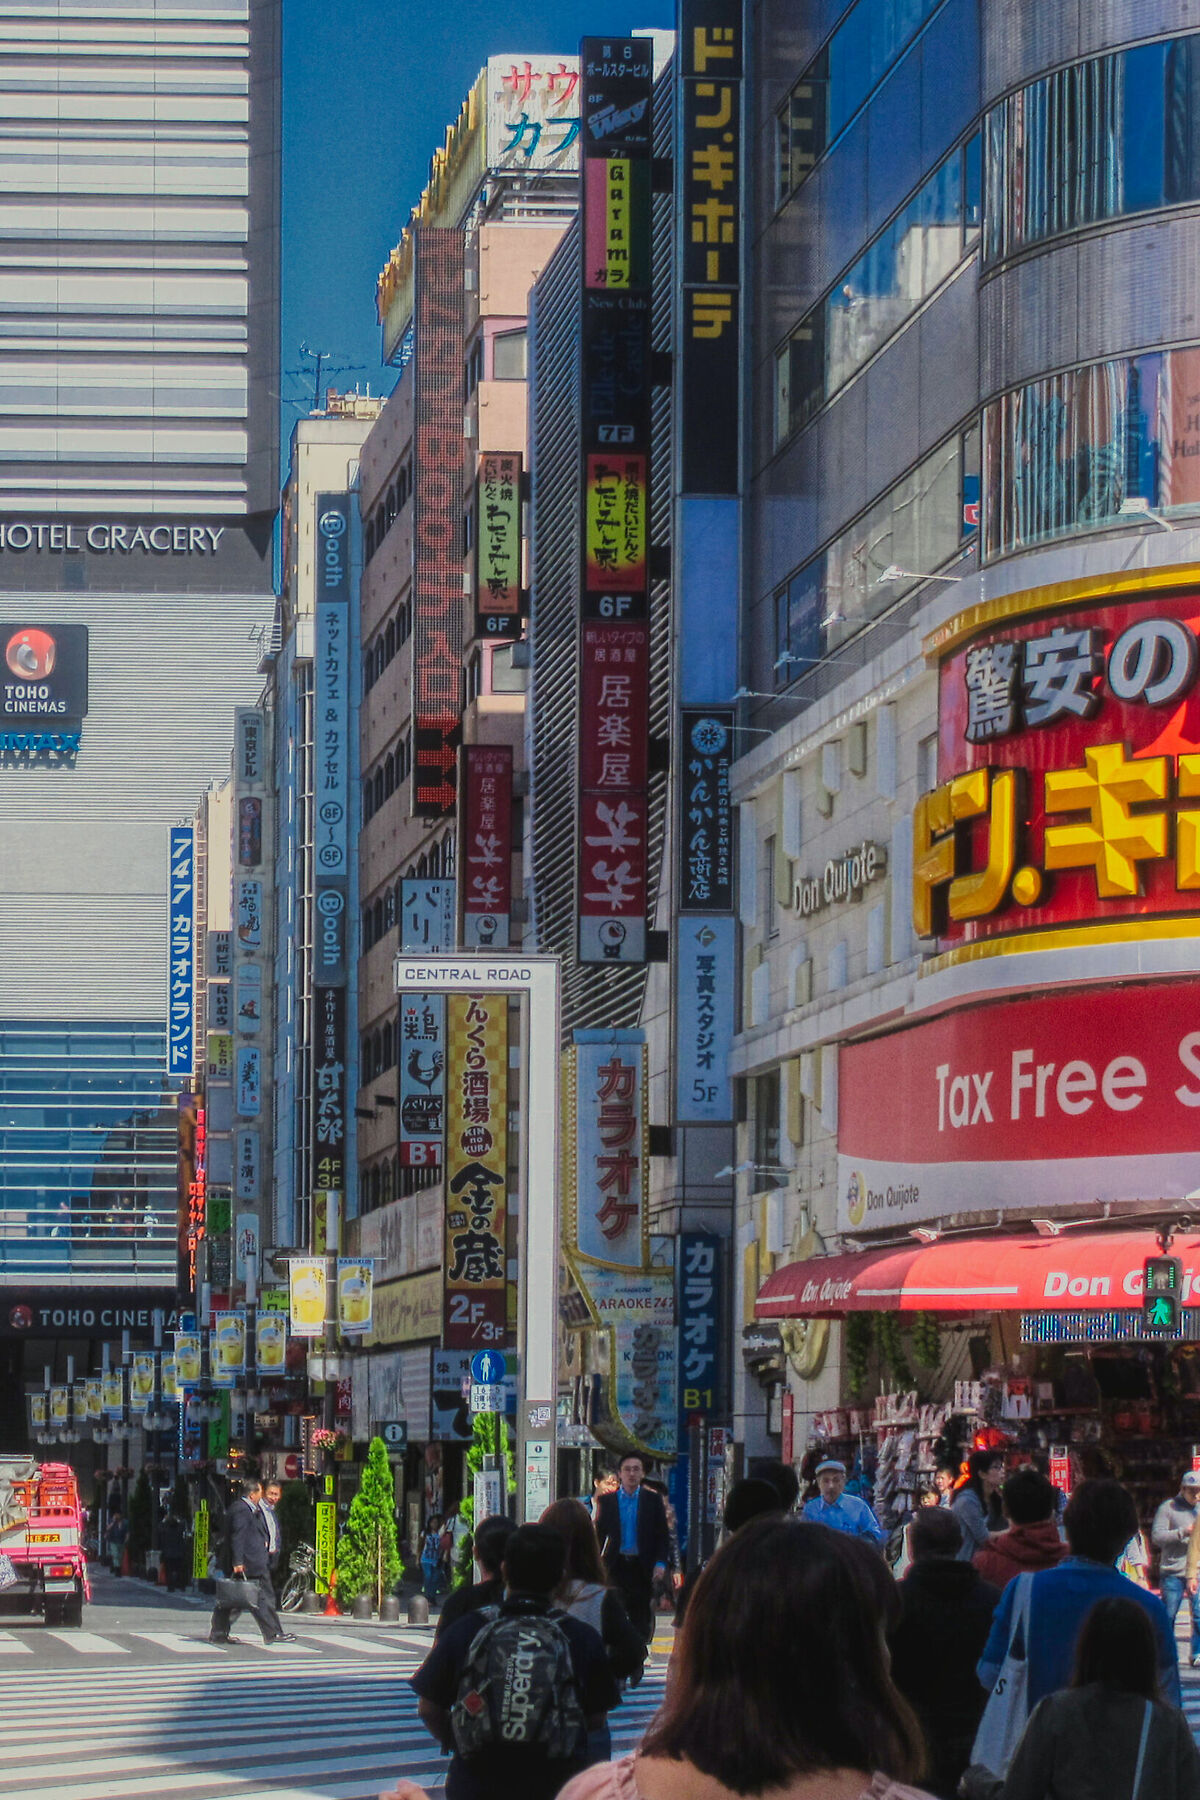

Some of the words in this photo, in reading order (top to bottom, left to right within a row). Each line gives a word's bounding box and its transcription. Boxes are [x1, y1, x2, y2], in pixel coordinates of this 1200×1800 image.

[623, 46, 633, 59] 6
[607, 165, 629, 262] Garam
[601, 427, 632, 441] 7F
[500, 458, 513, 501] 炭火焼
[594, 463, 621, 573] わたみん家
[86, 524, 225, 551] GRACERY
[318, 510, 347, 588] Booth
[599, 595, 632, 617] 6F
[486, 616, 510, 632] 6F
[585, 630, 645, 645] 新しいタイプの
[324, 610, 340, 701] ネットカフェ
[594, 648, 637, 663] 居酒屋
[4, 685, 49, 700] TOHO
[965, 617, 1190, 744] 驚安の
[4, 701, 67, 713] CINEMAS
[325, 707, 339, 722] &
[0, 732, 81, 751] IMAX
[597, 674, 632, 787] 居楽屋
[324, 729, 340, 790] カプセル
[323, 807, 340, 819] 8F
[479, 777, 496, 830] 居楽屋
[687, 757, 713, 899] かんかん商店
[323, 850, 339, 862] 5F
[170, 837, 193, 905] 747
[792, 876, 821, 918] Don
[823, 842, 878, 904] Quijote
[316, 889, 345, 966] Booth
[216, 932, 230, 974] 川新ビル
[405, 969, 481, 981] CENTRAL
[487, 968, 531, 981] ROAD
[170, 914, 193, 1066] カラオケランド
[696, 956, 717, 1069] 写真スタジオ
[315, 1061, 345, 1146] 甘太郎
[691, 1080, 718, 1102] 5F
[935, 1062, 995, 1132] Tax
[1010, 1048, 1148, 1121] Free
[464, 1127, 485, 1137] KIN
[409, 1143, 442, 1166] B1
[595, 1057, 639, 1241] カラオケ
[317, 1156, 342, 1173] 4F
[317, 1174, 342, 1189] 3F
[867, 1190, 885, 1208] Don
[886, 1185, 919, 1207] Quijote
[448, 1161, 504, 1283] 金の蔵
[800, 1280, 818, 1303] Don
[820, 1276, 852, 1304] Quijote
[1044, 1271, 1110, 1297] Don
[449, 1294, 485, 1325] 2F
[591, 1297, 652, 1310] KARAOKE
[682, 1242, 715, 1381] カラオケ
[39, 1310, 95, 1326] TOHO
[683, 1388, 712, 1408] B1
